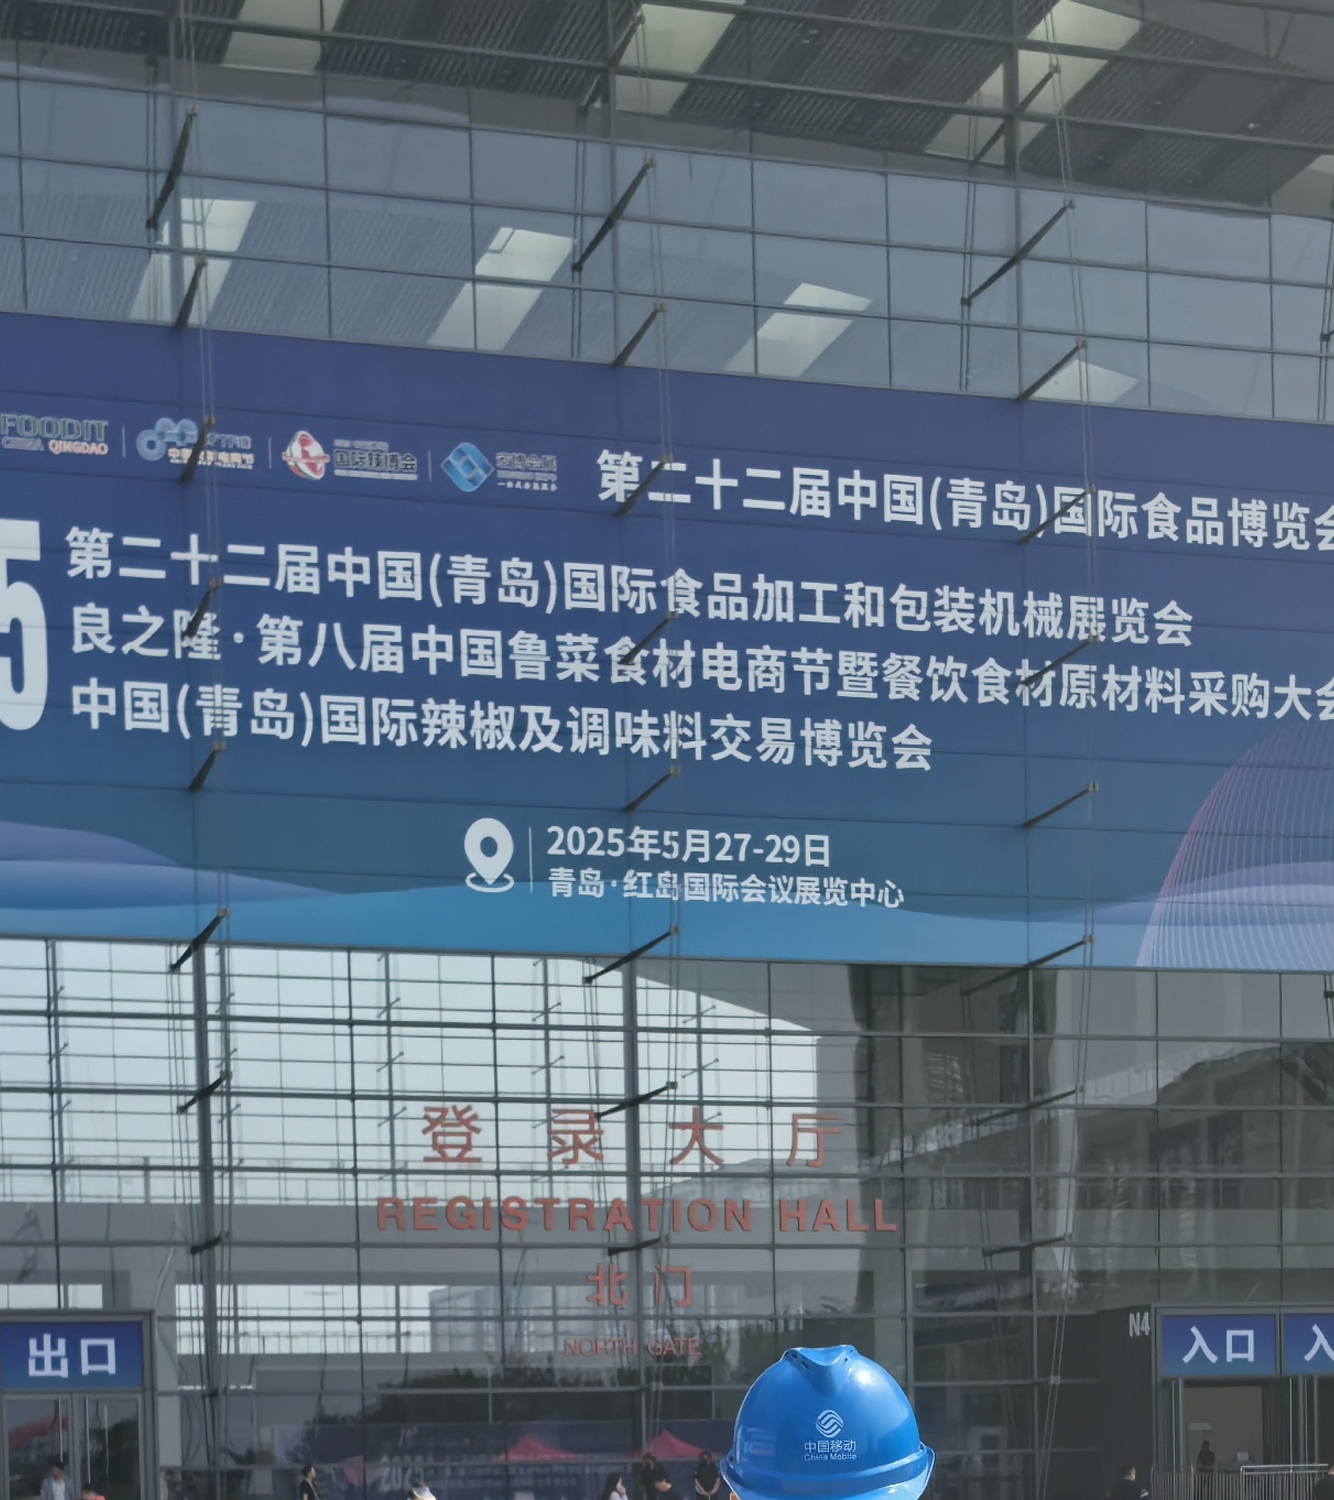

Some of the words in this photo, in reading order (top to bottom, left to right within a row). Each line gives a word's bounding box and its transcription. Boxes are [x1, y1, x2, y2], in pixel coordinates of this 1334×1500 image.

[48, 439, 108, 455] QINGDAO
[65, 526, 1194, 648] 第二十二届中国(青岛)国际食品加工和包装机械展览会
[72, 678, 933, 775] 中国(青岛)国际辣椒及调味料交易博览会
[547, 825, 831, 867] 2025年5月27-29日
[548, 866, 905, 909] 青岛·红岛国际会议展览中心
[422, 1105, 843, 1168] 登录大厅
[375, 1196, 753, 1233] REGISTRATION
[778, 1198, 898, 1233] HALL
[586, 1263, 694, 1309] 北门
[1129, 1313, 1150, 1338] N4
[1182, 1325, 1255, 1364] 入口
[28, 1333, 116, 1378] 出口
[564, 1337, 639, 1357] NORTH
[647, 1337, 702, 1357] GATE
[804, 1440, 857, 1454] 中国移动
